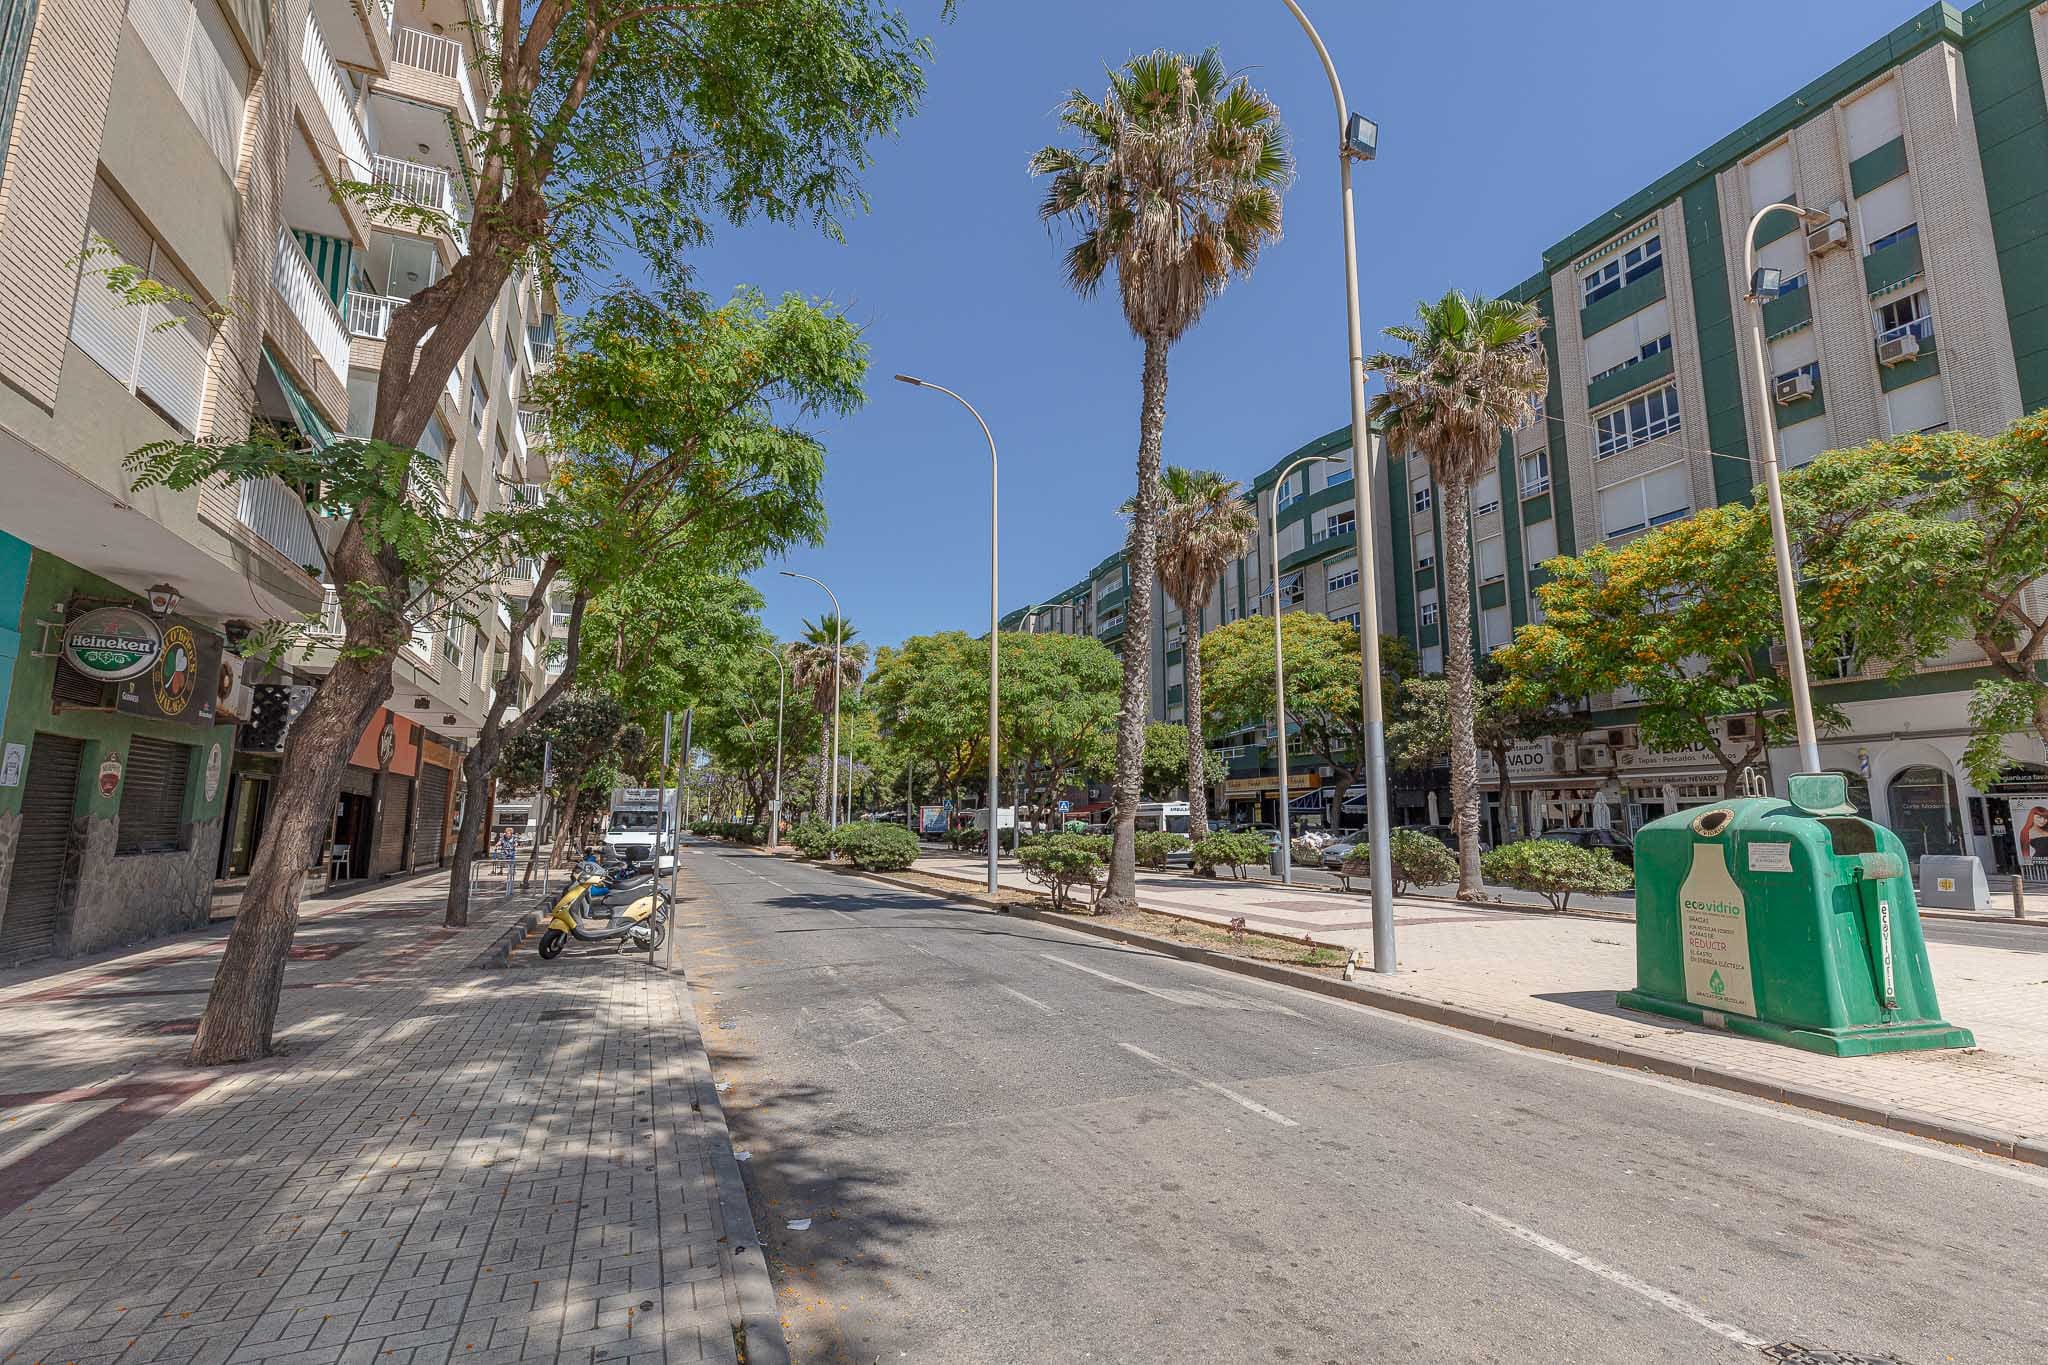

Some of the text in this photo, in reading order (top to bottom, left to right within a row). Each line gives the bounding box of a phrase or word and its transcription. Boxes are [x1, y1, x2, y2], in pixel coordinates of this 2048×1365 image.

[71, 635, 150, 652] Heineken
[1684, 899, 1740, 915] ecovidrio
[1689, 938, 1727, 951] REDUCIR
[1881, 905, 1893, 996] ecovidrio
